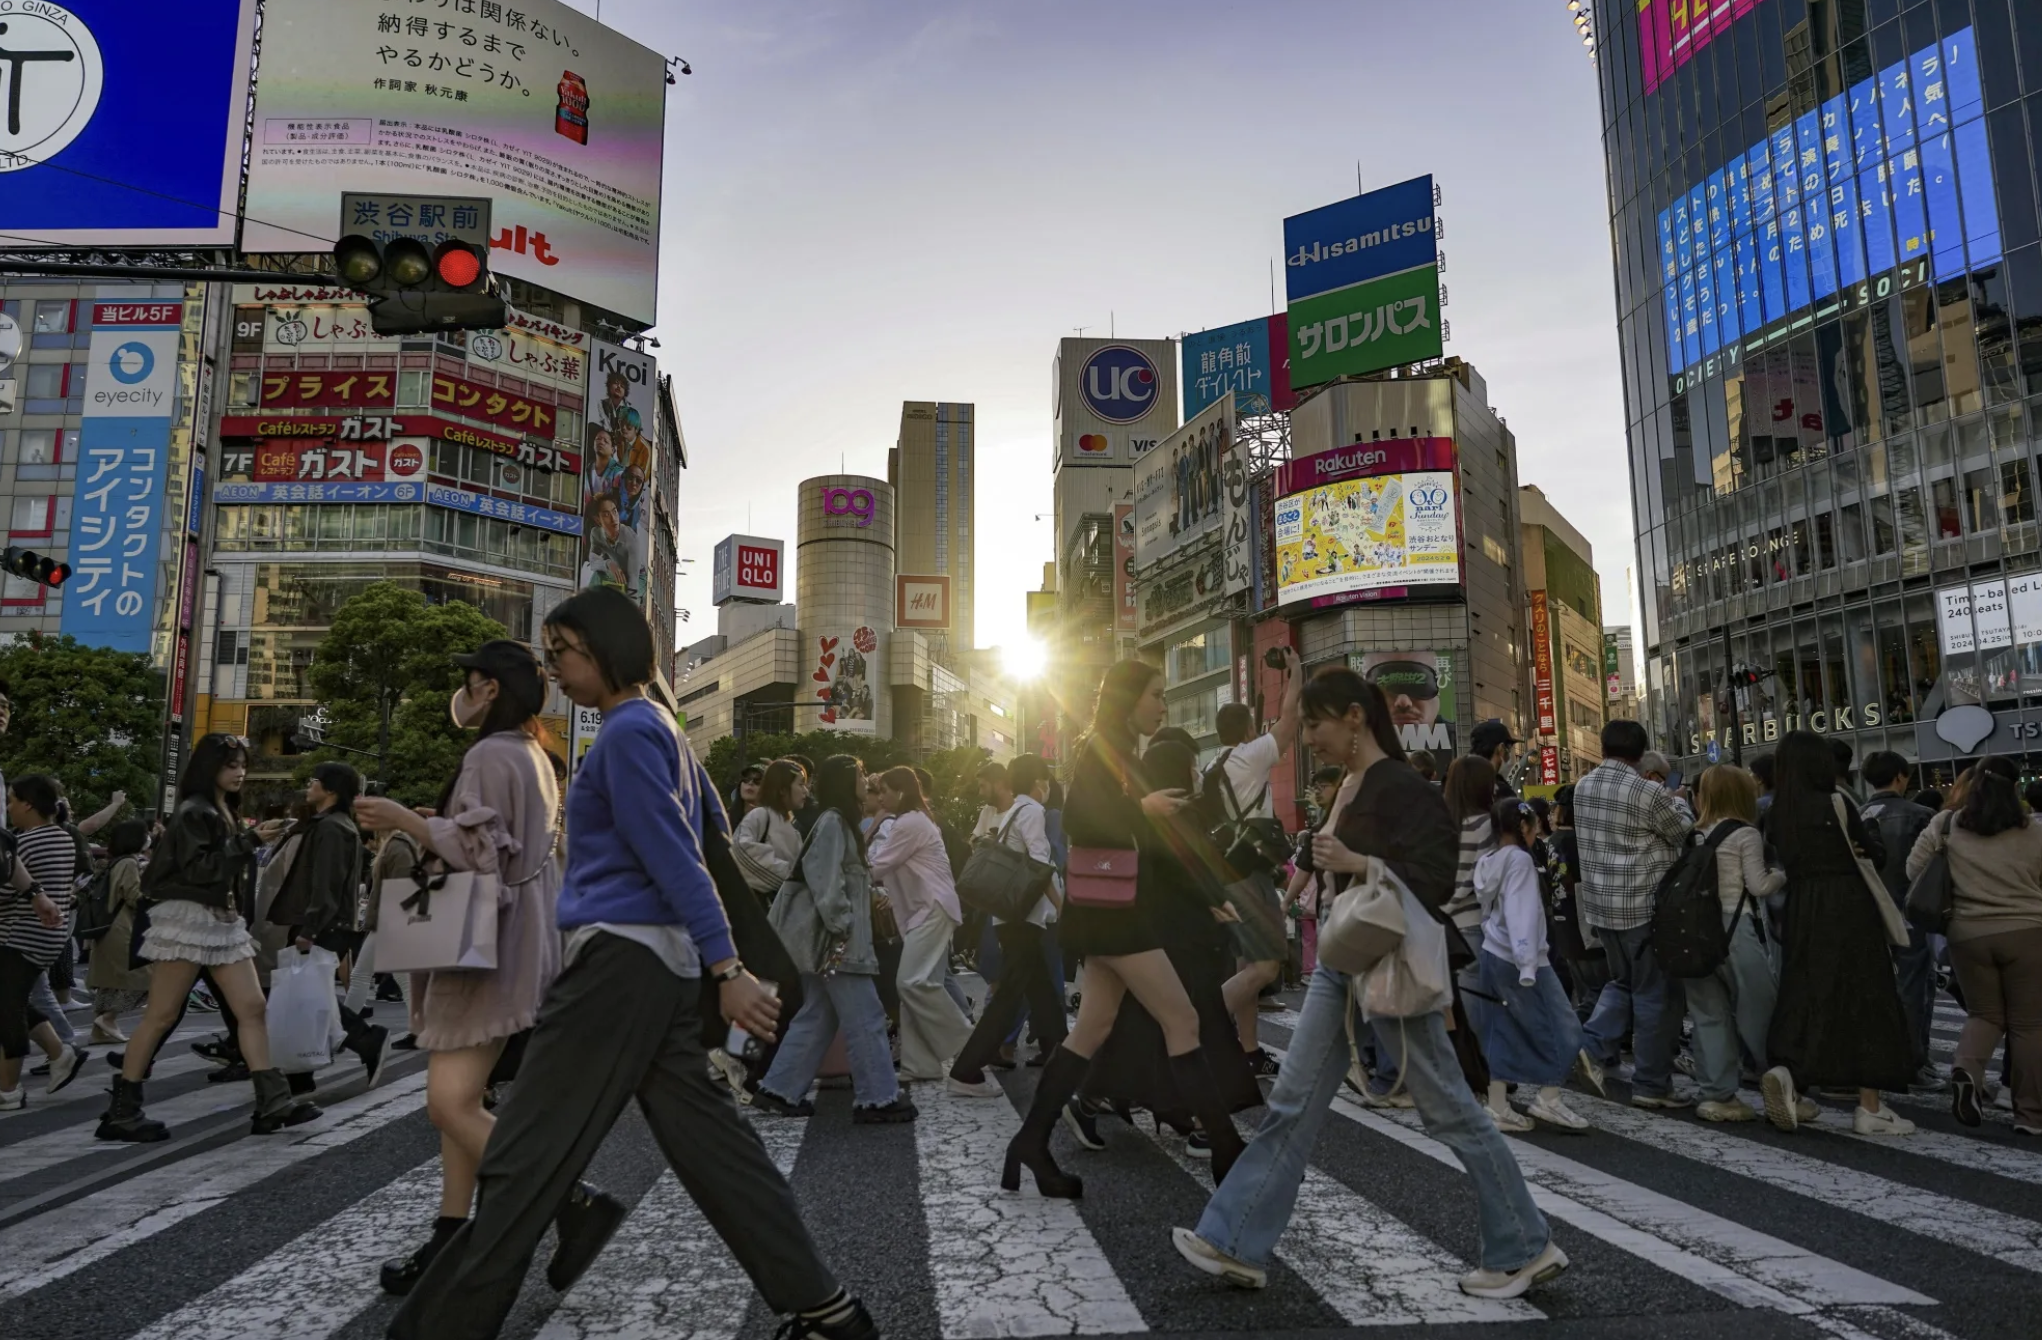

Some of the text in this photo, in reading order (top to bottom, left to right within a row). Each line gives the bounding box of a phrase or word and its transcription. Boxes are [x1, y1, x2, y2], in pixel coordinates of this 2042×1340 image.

[22, 0, 68, 26] GINZA
[378, 13, 526, 62] 納得するまで
[376, 45, 530, 97] やるかどうか。
[374, 78, 469, 102] 作詞家 秋元康
[287, 122, 350, 131] 機能性表示食品
[353, 201, 478, 229] 渋谷駅前
[489, 224, 559, 266] ult
[1287, 216, 1432, 267] Hisamitsu
[101, 306, 173, 321] 当ビル5F
[237, 322, 262, 337] 9F
[1297, 295, 1431, 360] サロンパス
[510, 338, 581, 381] しゃぶ葉
[598, 348, 647, 386] Kroi
[1200, 341, 1251, 374] 龍角散
[94, 388, 163, 406] eyecity
[264, 376, 391, 400] プライス
[433, 378, 550, 428] コンタクト
[340, 416, 403, 439] ガスト
[517, 443, 570, 472] ガスト
[1131, 439, 1158, 452] VIS
[224, 453, 253, 471] 7F
[261, 452, 296, 467] Café
[298, 448, 378, 479] ガスト
[393, 458, 420, 467] ガスト
[1315, 449, 1386, 475] Rakuten
[221, 485, 259, 497] AEON
[272, 484, 388, 500] 英会話イーオン
[434, 488, 471, 506] AEON
[479, 497, 580, 530] 英会話イーオン
[820, 487, 875, 527] 109
[1224, 449, 1250, 587] もんじゃ
[76, 448, 125, 616] アイシティ
[115, 448, 155, 616] コンタクトの
[1408, 535, 1455, 544] 渋谷おとなり
[1409, 543, 1437, 551] サンデー
[1742, 531, 1798, 560] LONGE
[742, 551, 771, 567] UNI
[742, 567, 773, 584] QLO
[910, 593, 937, 610] H&M
[1945, 583, 2027, 606] Time-baed
[1534, 593, 1548, 672] クスリのことなら
[1950, 632, 1975, 641] SHIBUY
[1434, 655, 1453, 689] 再び
[1537, 678, 1554, 729] 三千里
[2009, 722, 2042, 740] TS
